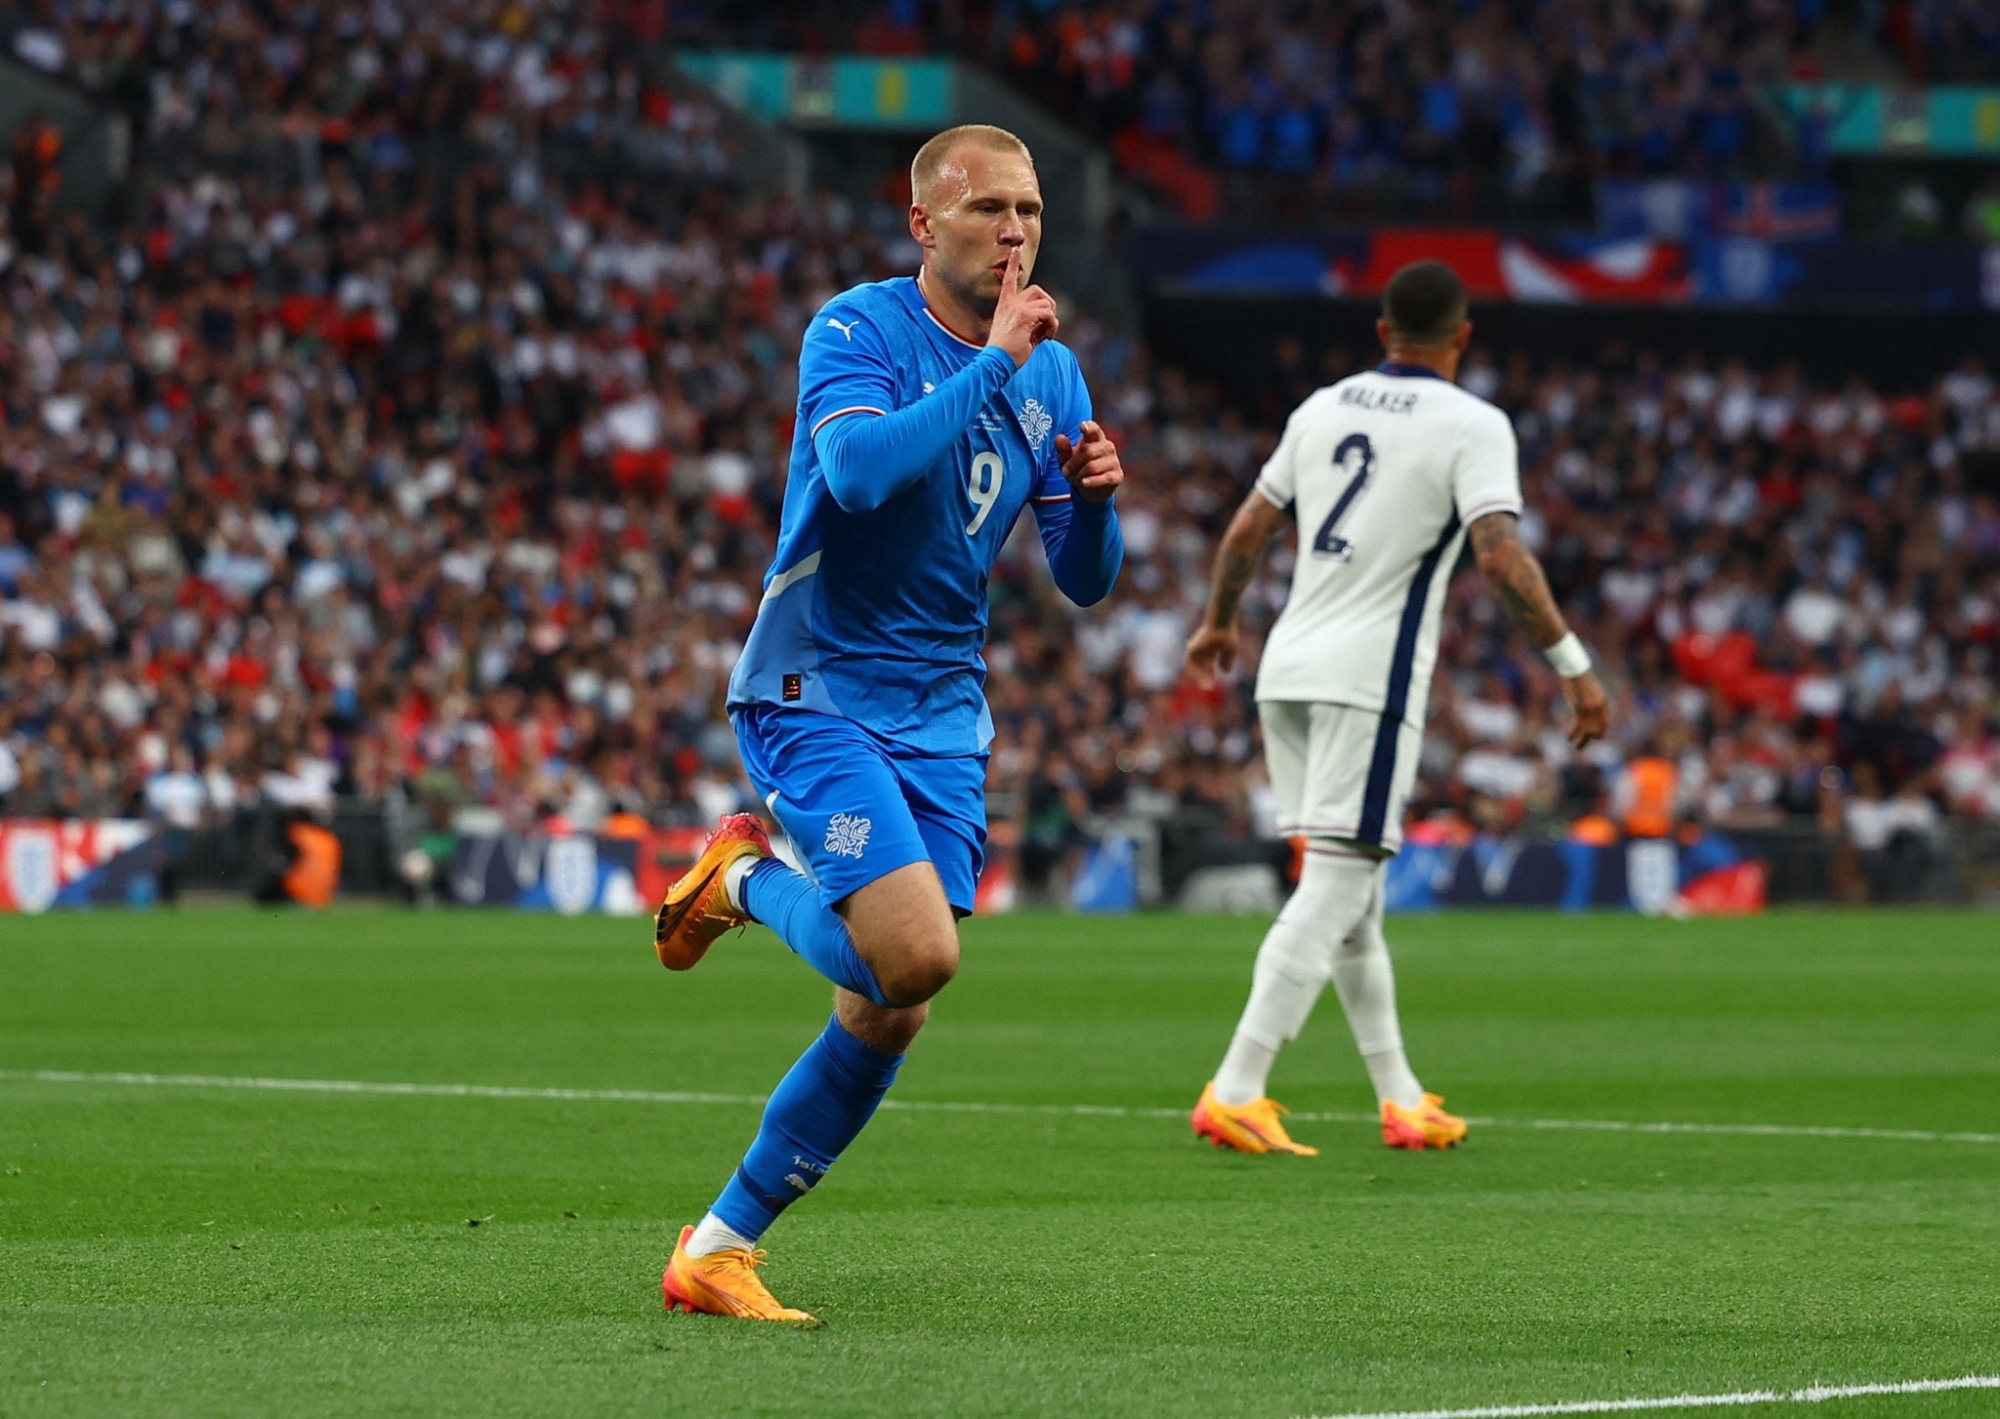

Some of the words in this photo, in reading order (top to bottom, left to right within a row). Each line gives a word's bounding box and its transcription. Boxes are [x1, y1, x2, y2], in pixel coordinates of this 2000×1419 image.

[1338, 387, 1418, 415] WALKER
[966, 451, 1004, 536] 9
[1313, 432, 1375, 562] 2
